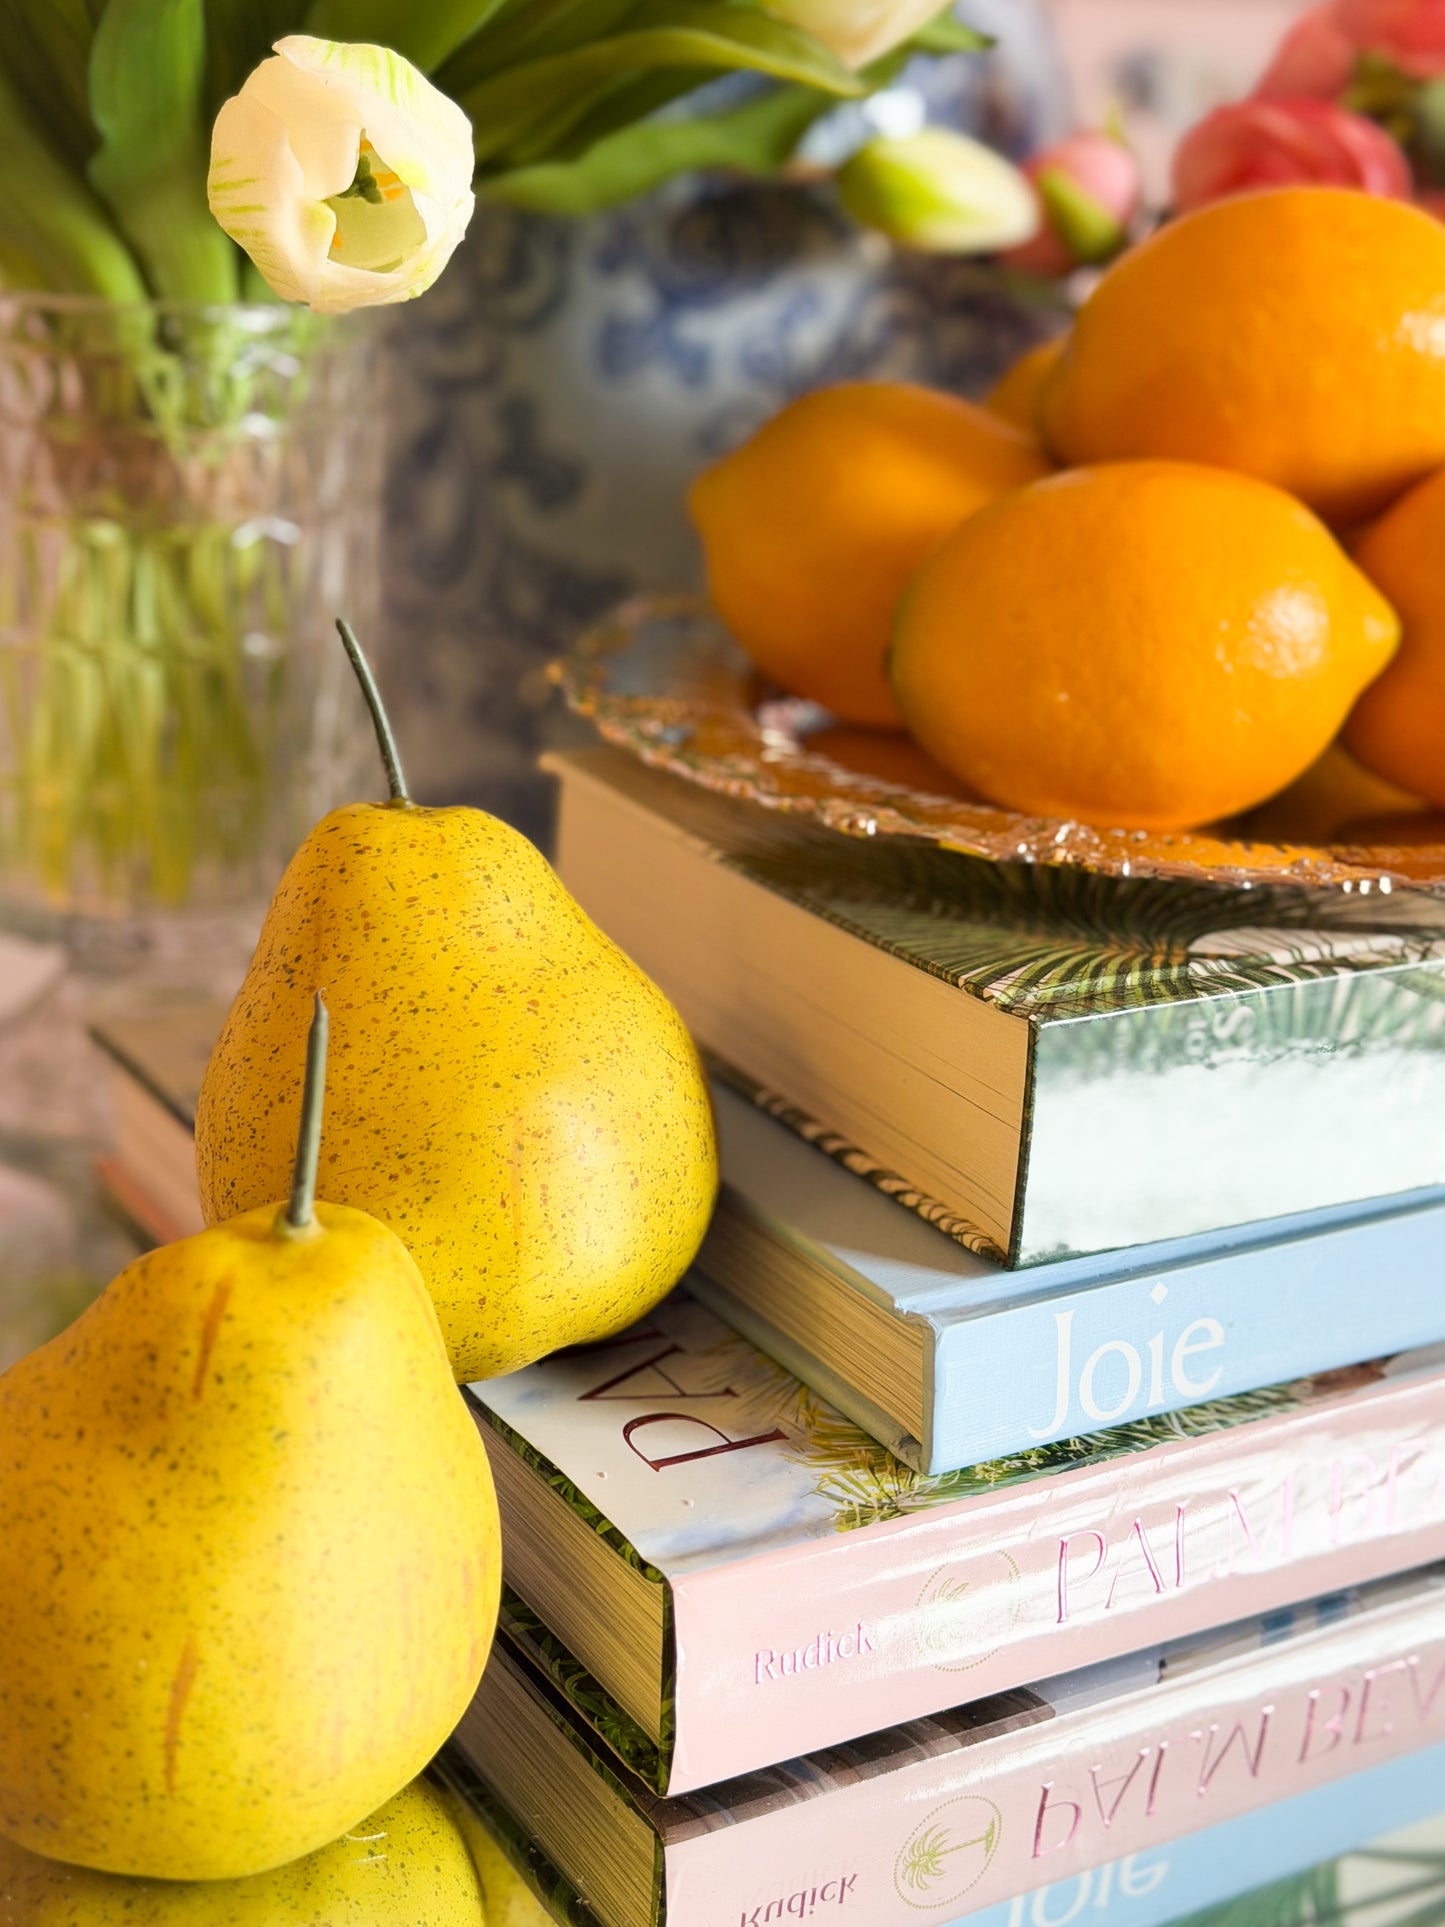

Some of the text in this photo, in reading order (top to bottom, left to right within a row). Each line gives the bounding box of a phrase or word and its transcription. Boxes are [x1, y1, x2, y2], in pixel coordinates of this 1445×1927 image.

[1028, 1281, 1226, 1439] Joie
[755, 1620, 878, 1684] Rudick
[1328, 1436, 1445, 1545] BE
